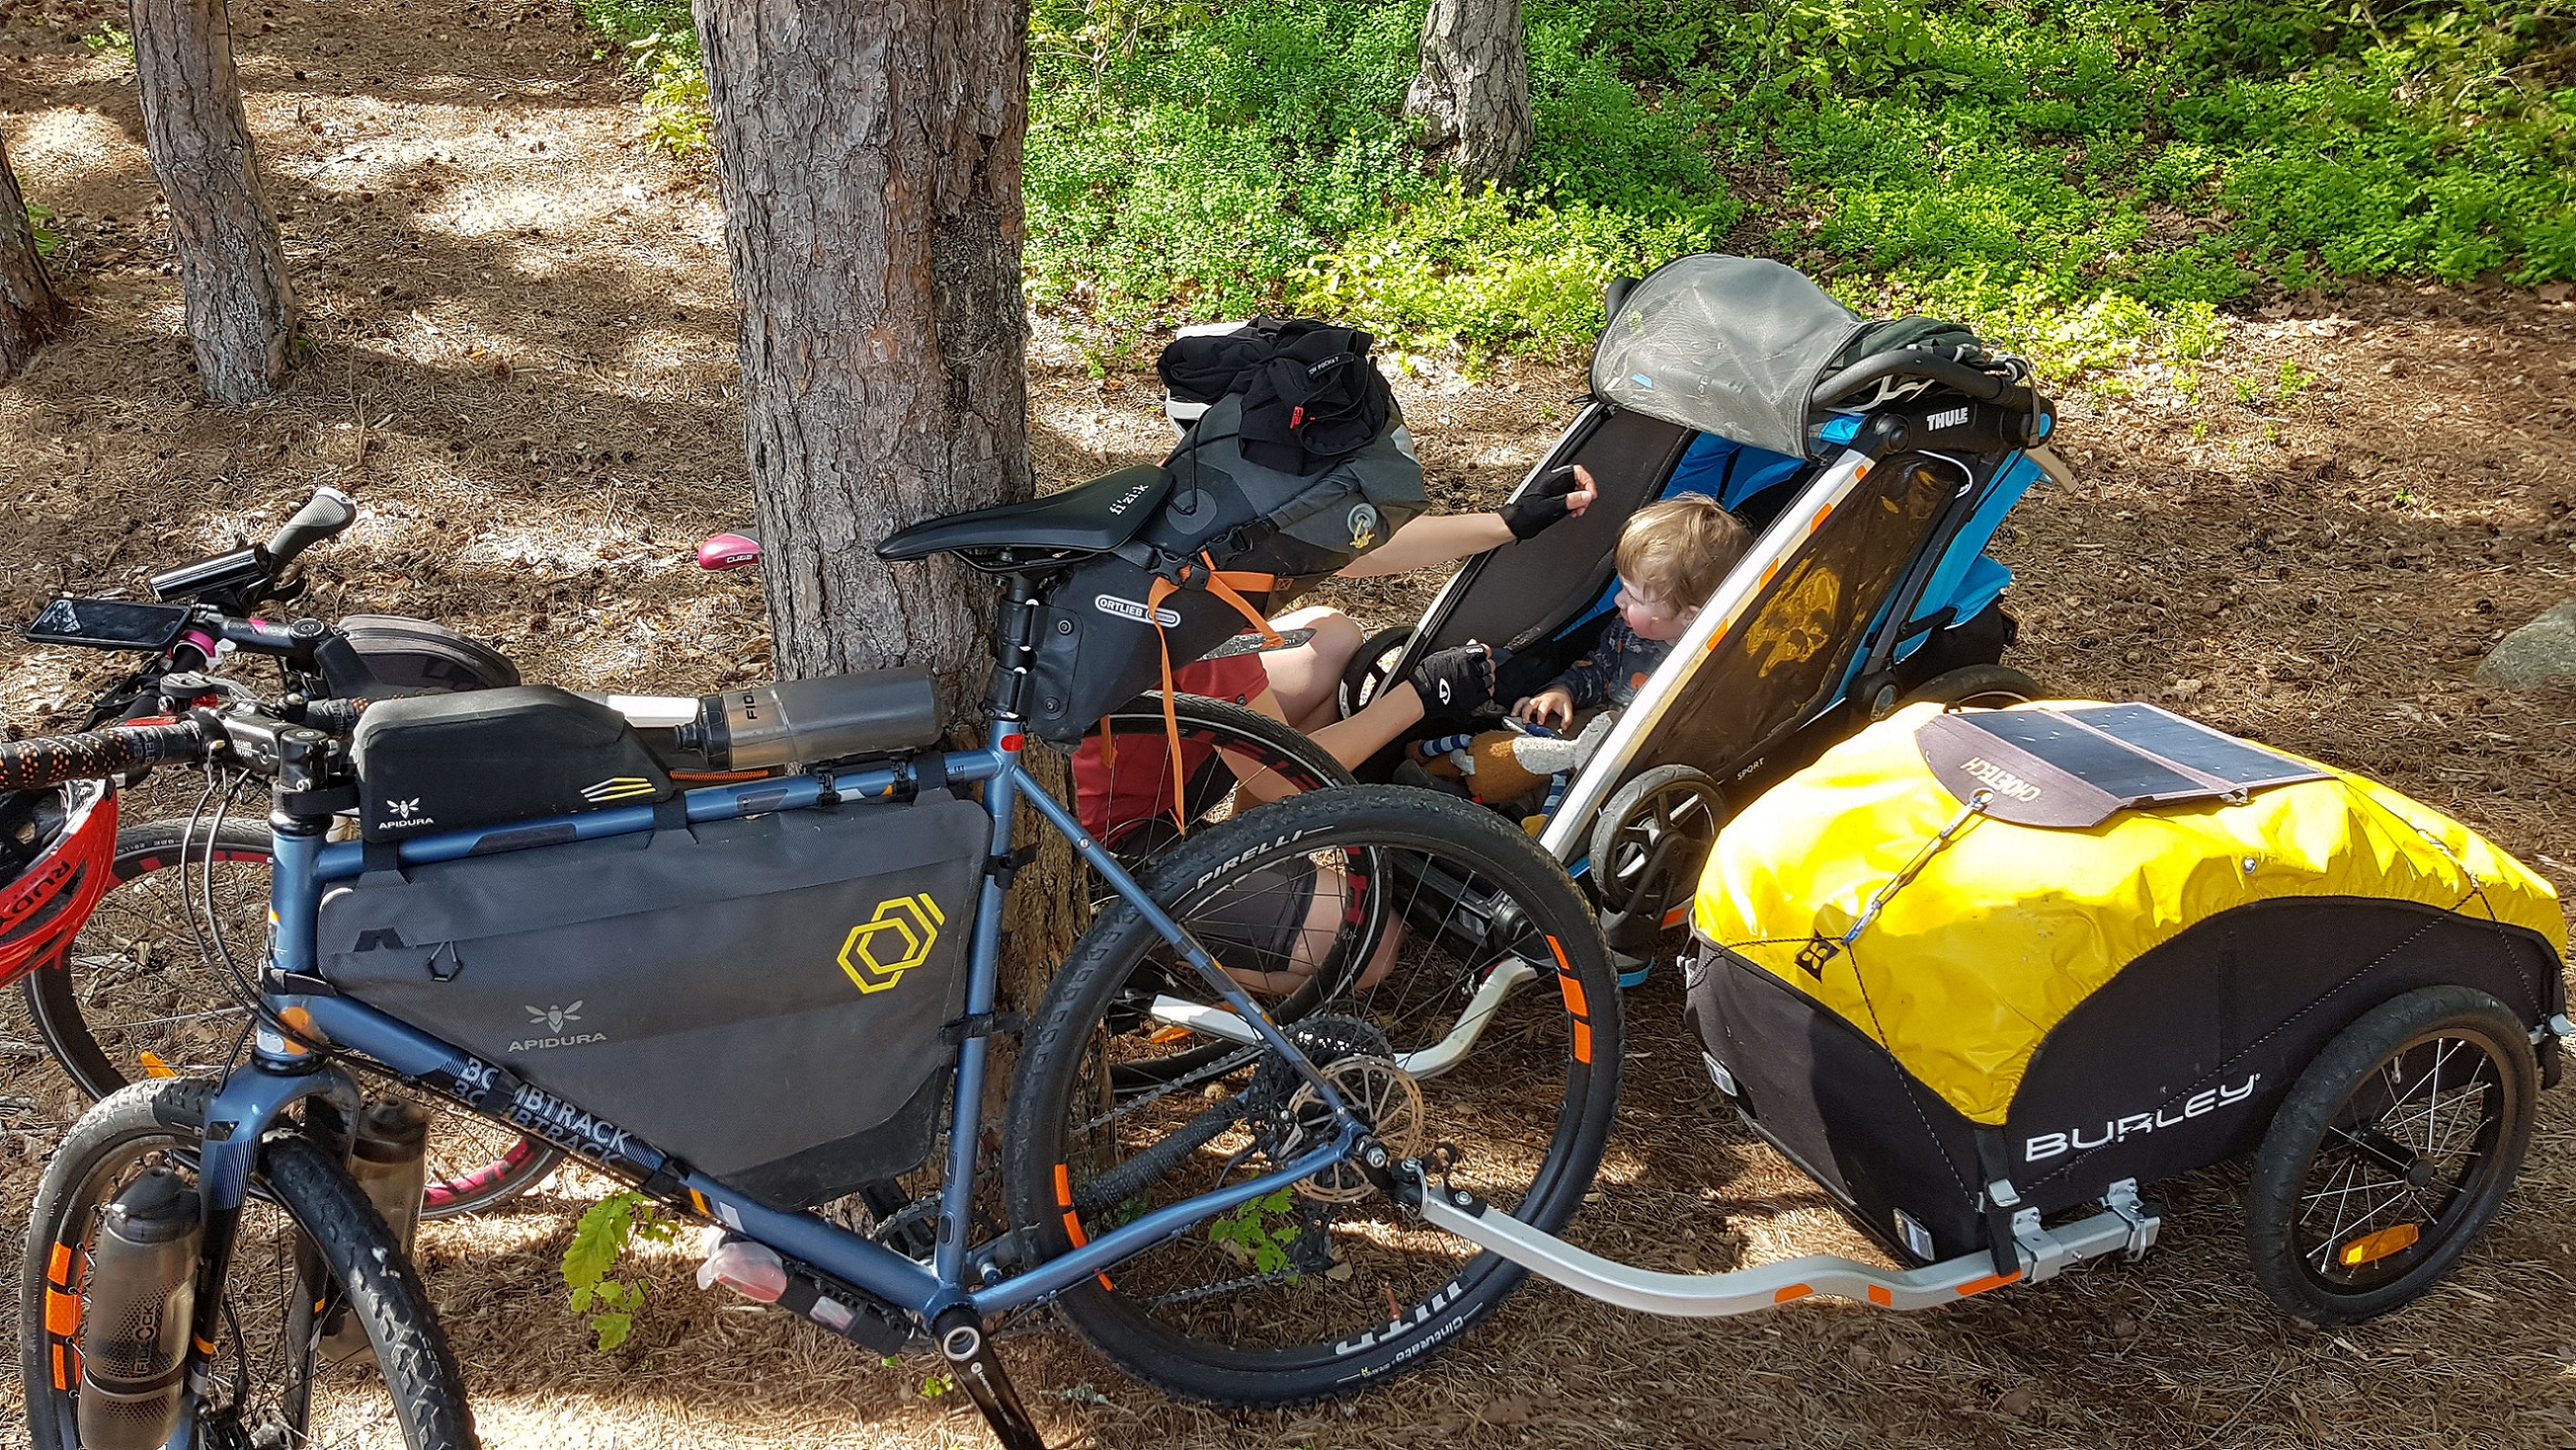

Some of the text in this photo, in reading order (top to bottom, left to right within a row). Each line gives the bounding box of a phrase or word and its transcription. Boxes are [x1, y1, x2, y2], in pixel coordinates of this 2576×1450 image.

[1926, 407, 1969, 432] THULE
[1100, 598, 1144, 616] ORTLIEB
[1737, 757, 1764, 780] SPORT
[1960, 757, 2041, 802] CHOETECH
[379, 818, 434, 829] APIDURA
[1196, 830, 1303, 889] PIRELLI
[0, 861, 71, 929] RUDY
[508, 1032, 607, 1052] APIDURA
[2026, 1074, 2256, 1162] BURLEY
